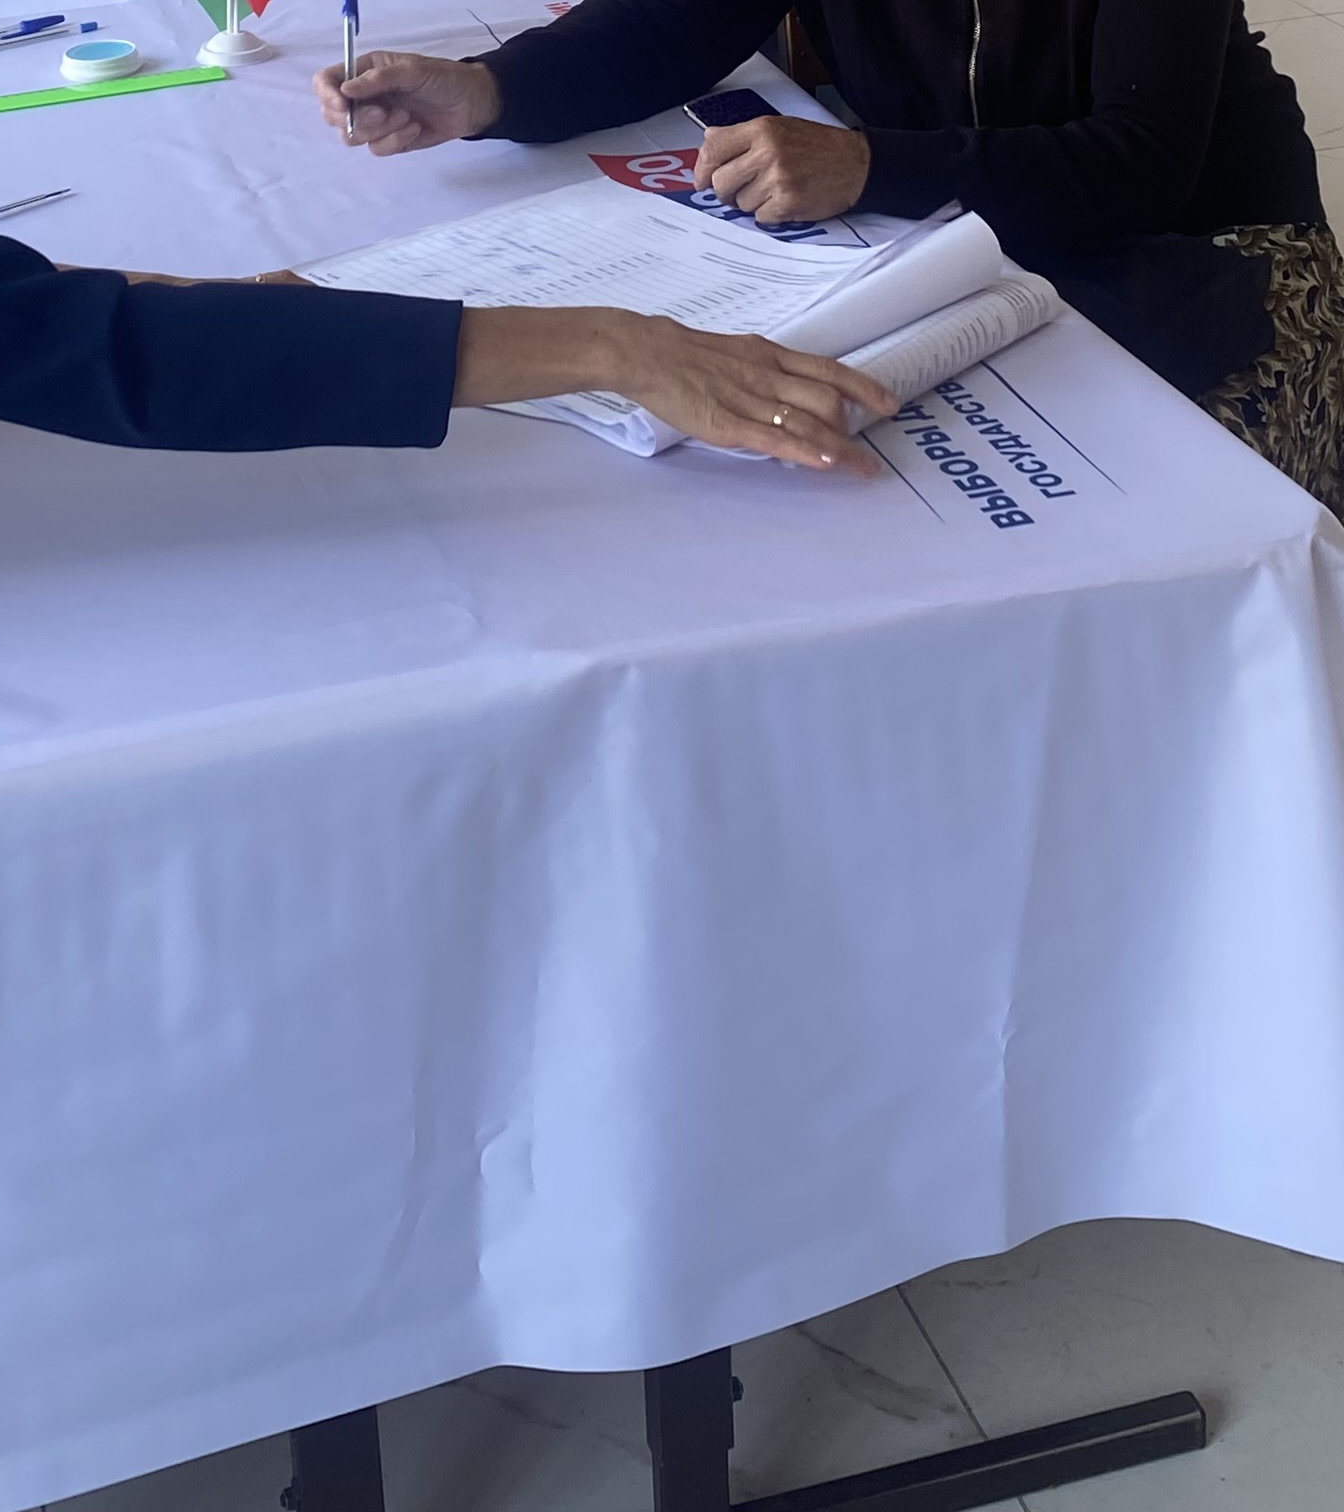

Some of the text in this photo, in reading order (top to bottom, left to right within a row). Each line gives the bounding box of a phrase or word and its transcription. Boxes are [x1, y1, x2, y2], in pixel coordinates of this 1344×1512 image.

[626, 154, 696, 190] 20
[903, 425, 1036, 529] ВЫБОРЫ
[936, 378, 1077, 499] ГОСУДАРСТВ
